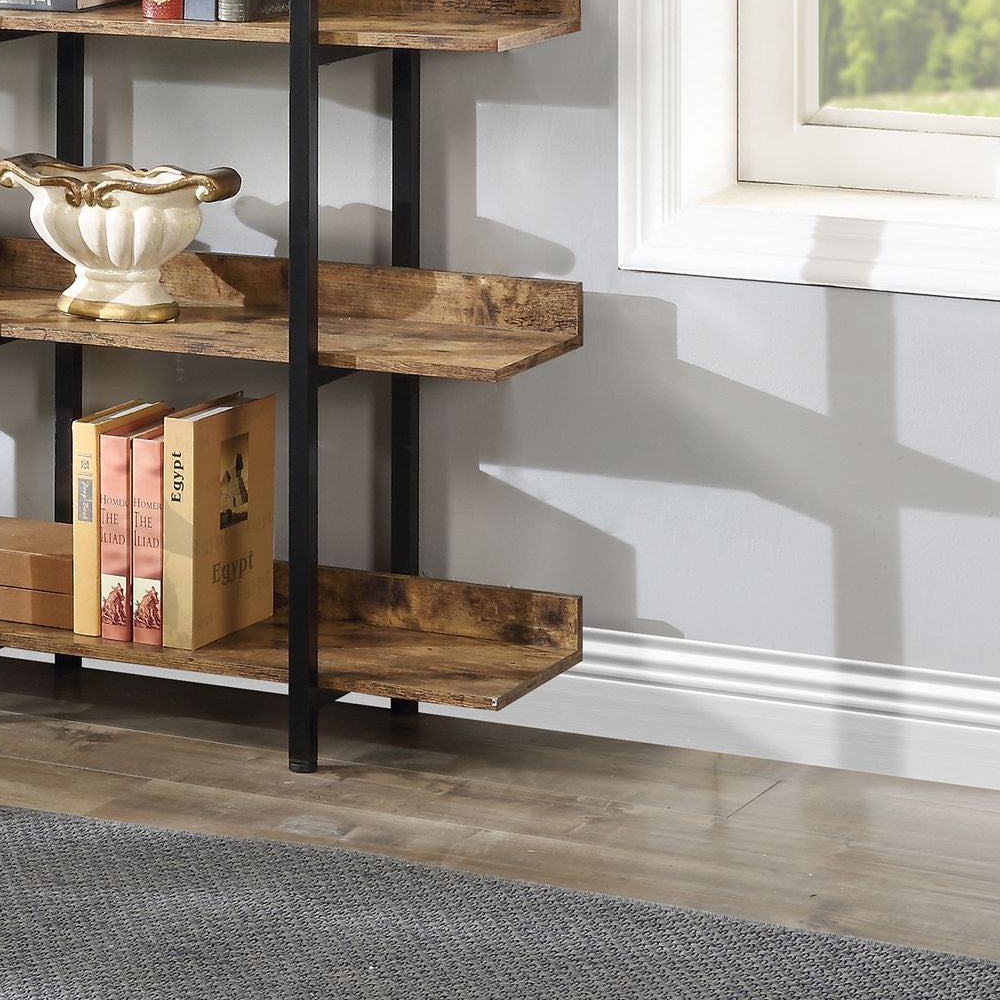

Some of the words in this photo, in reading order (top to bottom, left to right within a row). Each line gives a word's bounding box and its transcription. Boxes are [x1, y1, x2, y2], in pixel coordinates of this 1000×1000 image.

[170, 450, 184, 503] Egypt
[101, 494, 128, 507] HOMER
[134, 498, 162, 511] HOMER
[101, 508, 119, 525] THE
[134, 511, 153, 529] THE
[134, 530, 160, 548] ILIAD
[212, 550, 255, 586] Egypt
